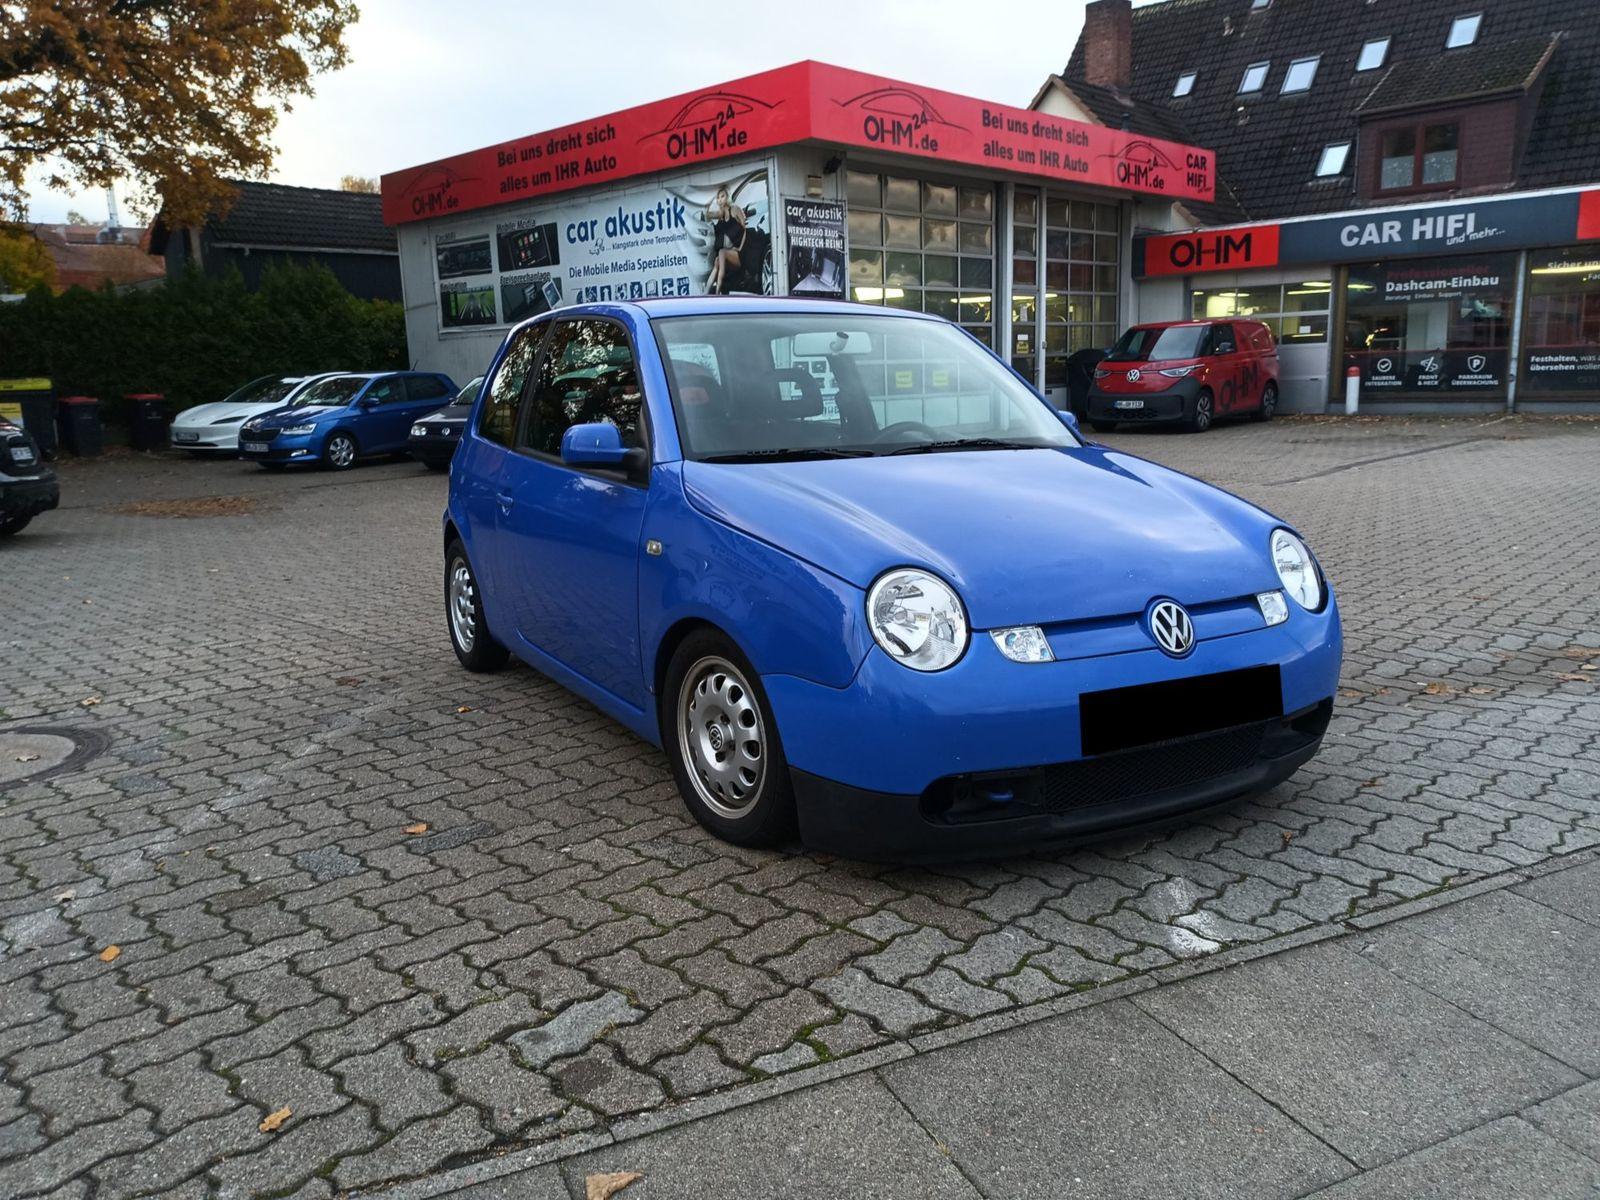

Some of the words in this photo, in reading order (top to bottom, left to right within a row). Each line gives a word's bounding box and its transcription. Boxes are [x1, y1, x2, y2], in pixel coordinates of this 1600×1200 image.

[982, 109, 1003, 129] Bei
[1007, 118, 1029, 135] uns
[1032, 121, 1063, 142] dreht
[1066, 127, 1089, 147] sich
[497, 148, 517, 167] Bei
[520, 145, 543, 162] uns
[546, 132, 582, 156] dreht
[586, 123, 616, 146] sich
[984, 141, 1014, 161] alles
[1017, 150, 1035, 164] um
[1039, 151, 1060, 169] IHR
[1063, 156, 1089, 173] Auto
[1186, 153, 1207, 170] CAR
[500, 176, 529, 194] alles
[532, 170, 552, 187] um
[555, 160, 580, 181] IHR
[584, 155, 617, 175] Auto
[1187, 171, 1206, 188] HIFI
[567, 219, 598, 244] car
[605, 197, 686, 238] akustik
[786, 205, 804, 217] car
[807, 206, 843, 220] akustik
[787, 226, 824, 237] WERKSRADIO
[1340, 220, 1402, 247] CAR
[1412, 212, 1476, 241] HIFI
[612, 238, 639, 250] klangstark
[640, 237, 655, 246] ohne
[791, 236, 824, 248] HIGHTECH
[825, 238, 844, 250] REIN!
[1170, 233, 1252, 267] OHM
[1446, 234, 1465, 246] und
[569, 266, 582, 278] Die
[583, 263, 609, 277] Mobile
[611, 259, 636, 273] Media
[638, 255, 688, 272] Spezialisten
[1386, 275, 1499, 292] Dashcam-Einbau
[1530, 363, 1575, 371] übersehen
[1220, 360, 1258, 409] OHM
